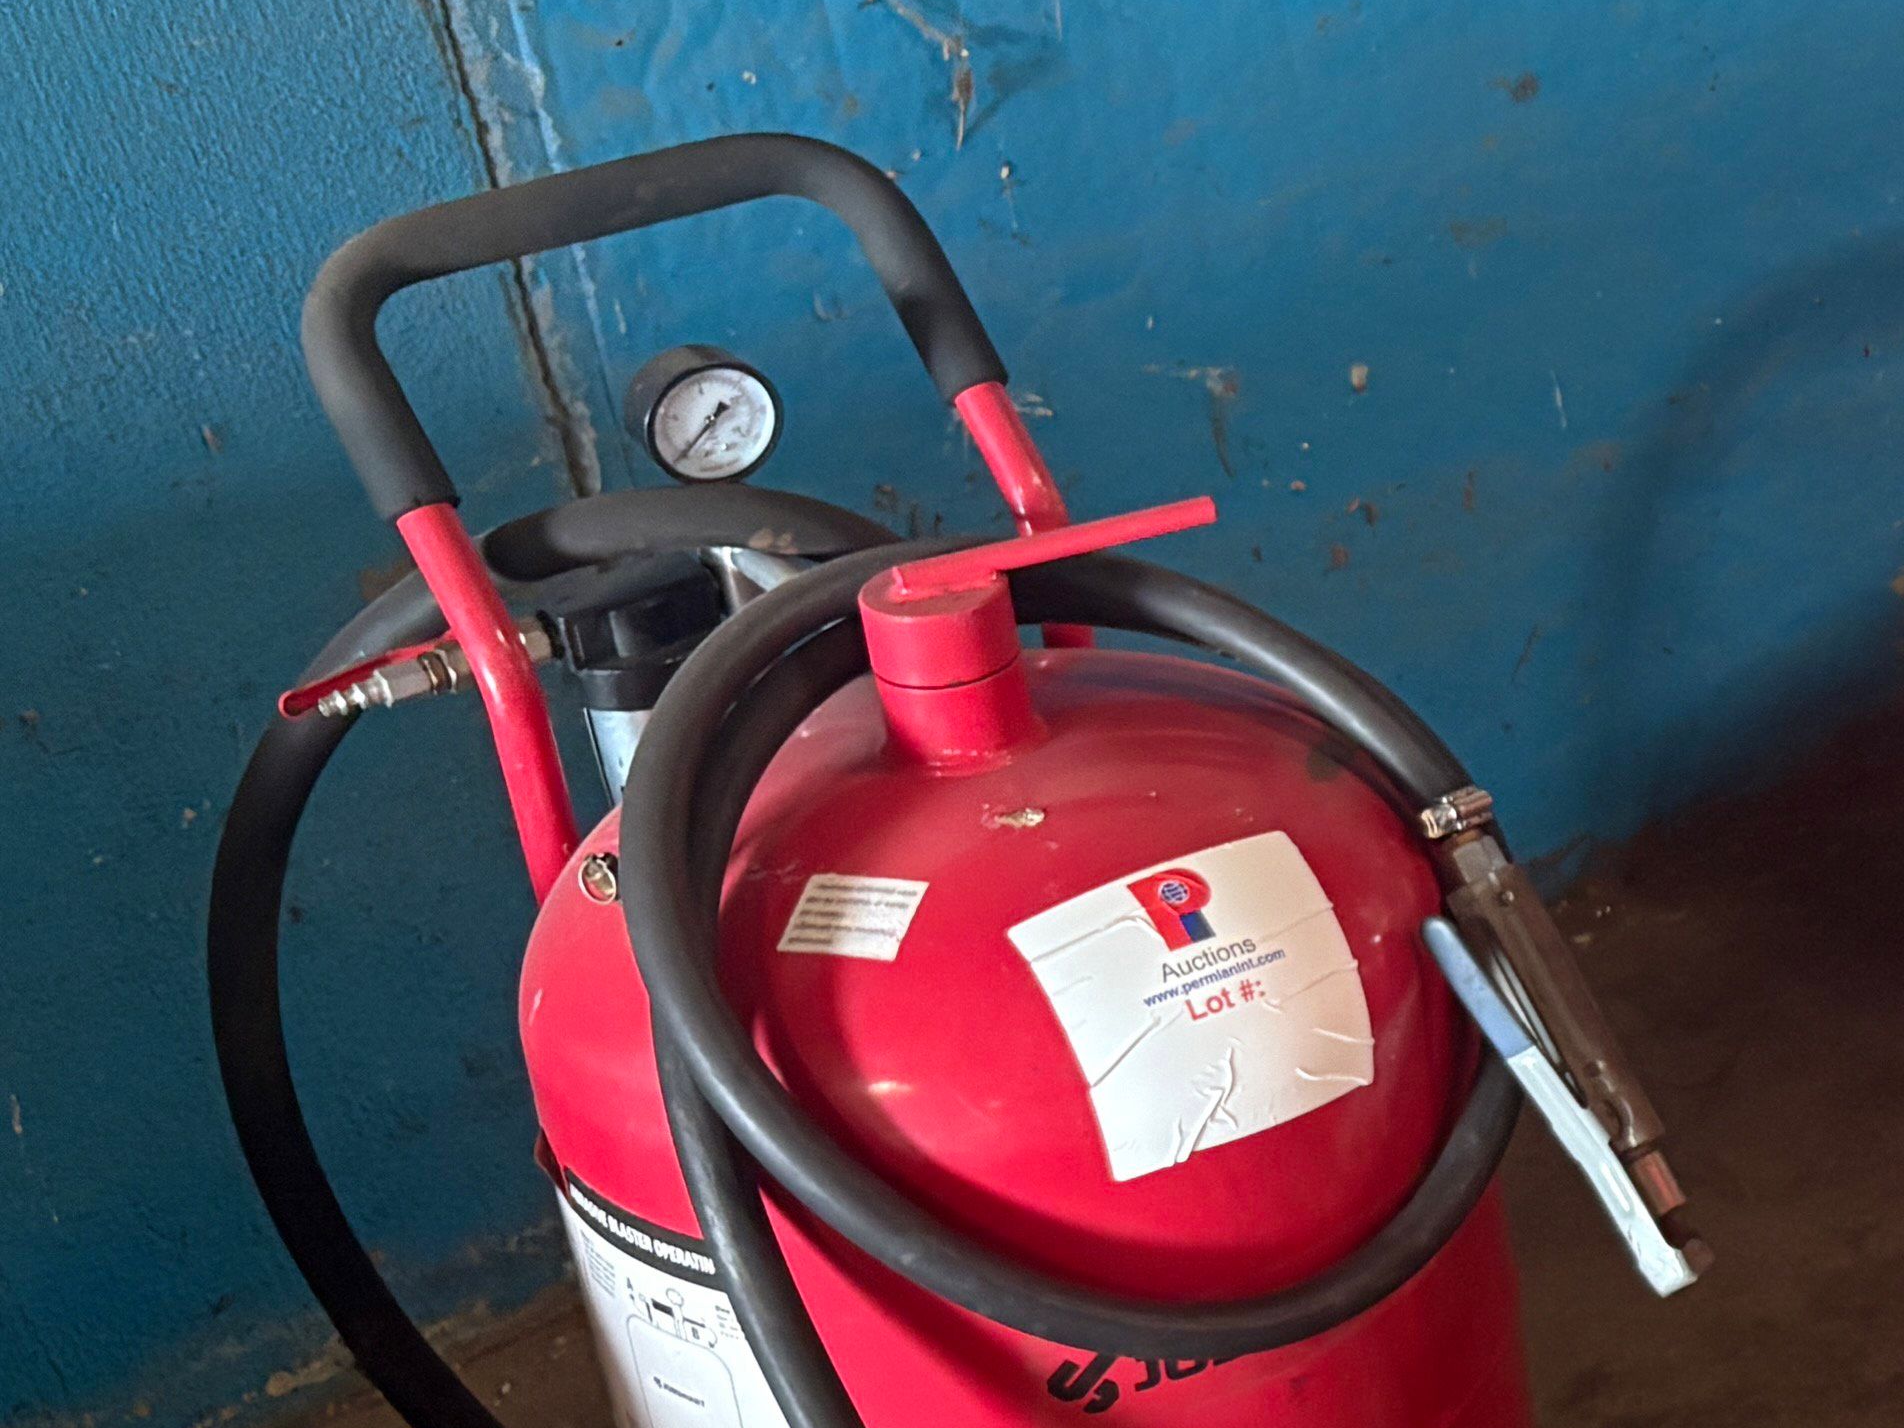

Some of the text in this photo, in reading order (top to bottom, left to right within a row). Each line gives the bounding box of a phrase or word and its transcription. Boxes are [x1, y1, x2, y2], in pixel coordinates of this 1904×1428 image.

[1142, 948, 1287, 1008] www.permianint.com
[1161, 938, 1257, 984] Auctions
[1185, 978, 1267, 1022] Lot #:
